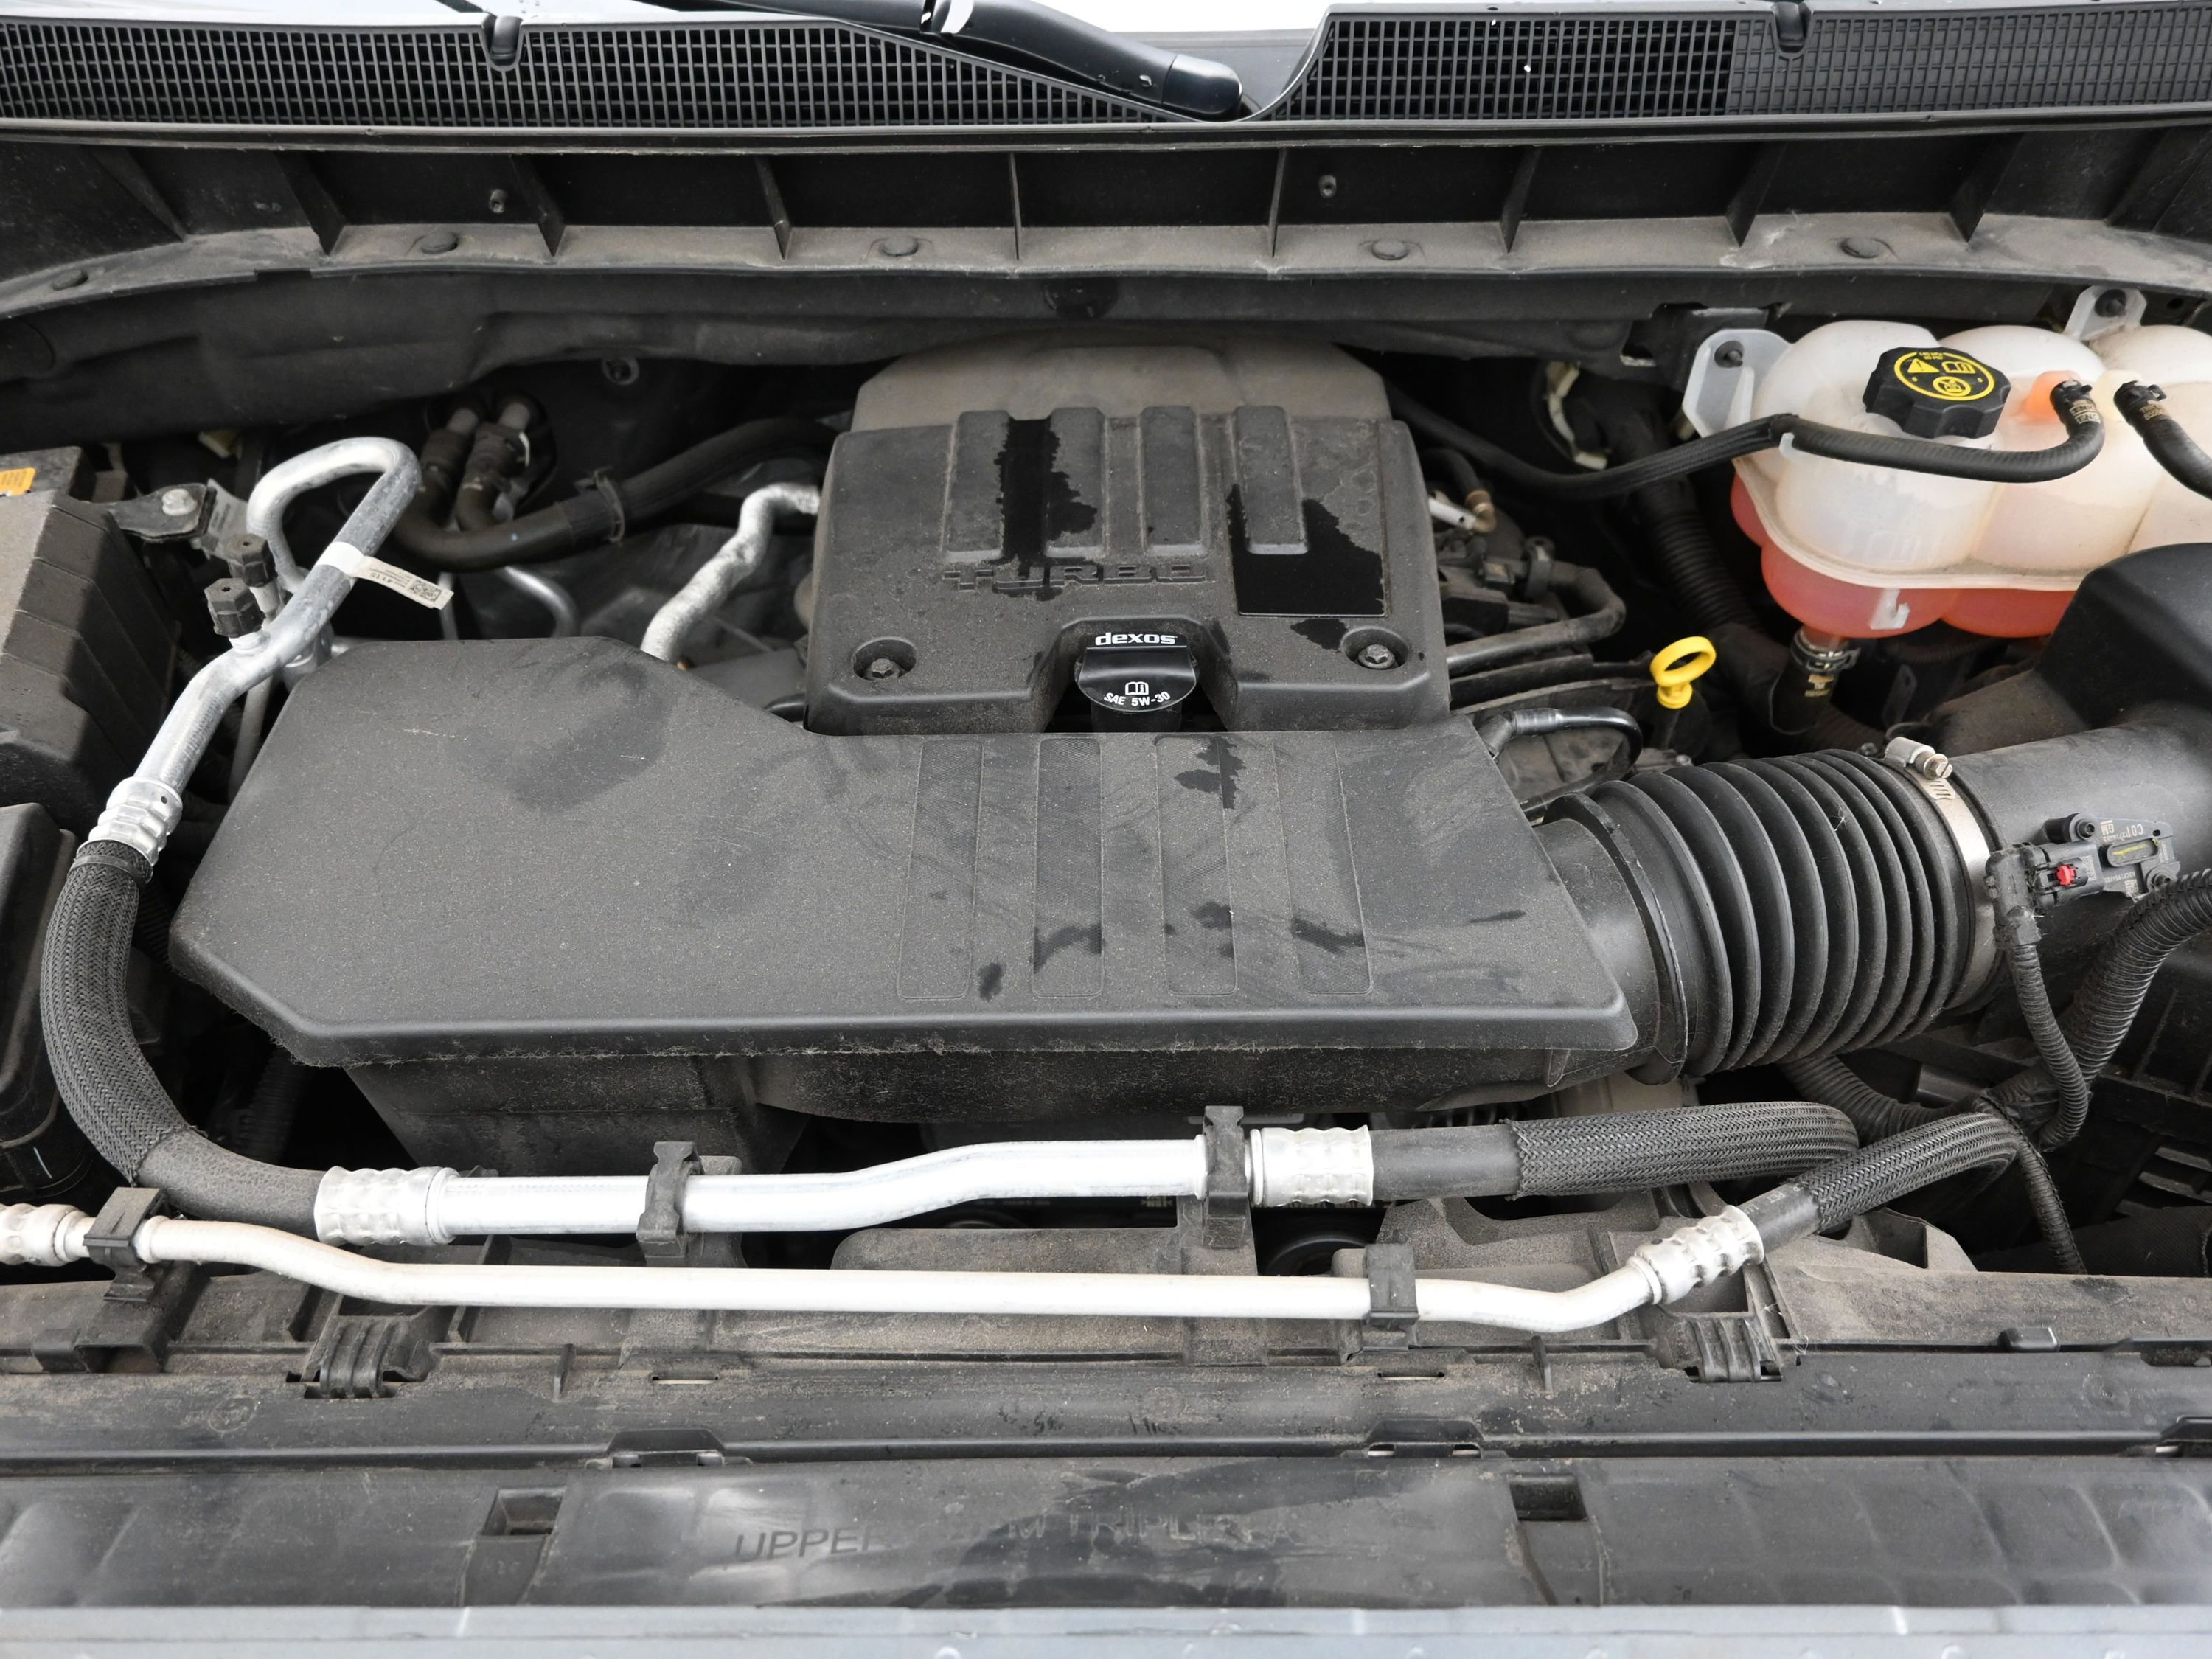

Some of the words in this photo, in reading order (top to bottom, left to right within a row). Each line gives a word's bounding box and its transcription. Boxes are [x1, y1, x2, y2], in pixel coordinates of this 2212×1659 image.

[942, 563, 1206, 591] TURBO
[1095, 632, 1176, 646] dexos
[1103, 692, 1126, 706] SAE
[1131, 691, 1171, 706] 5W-30
